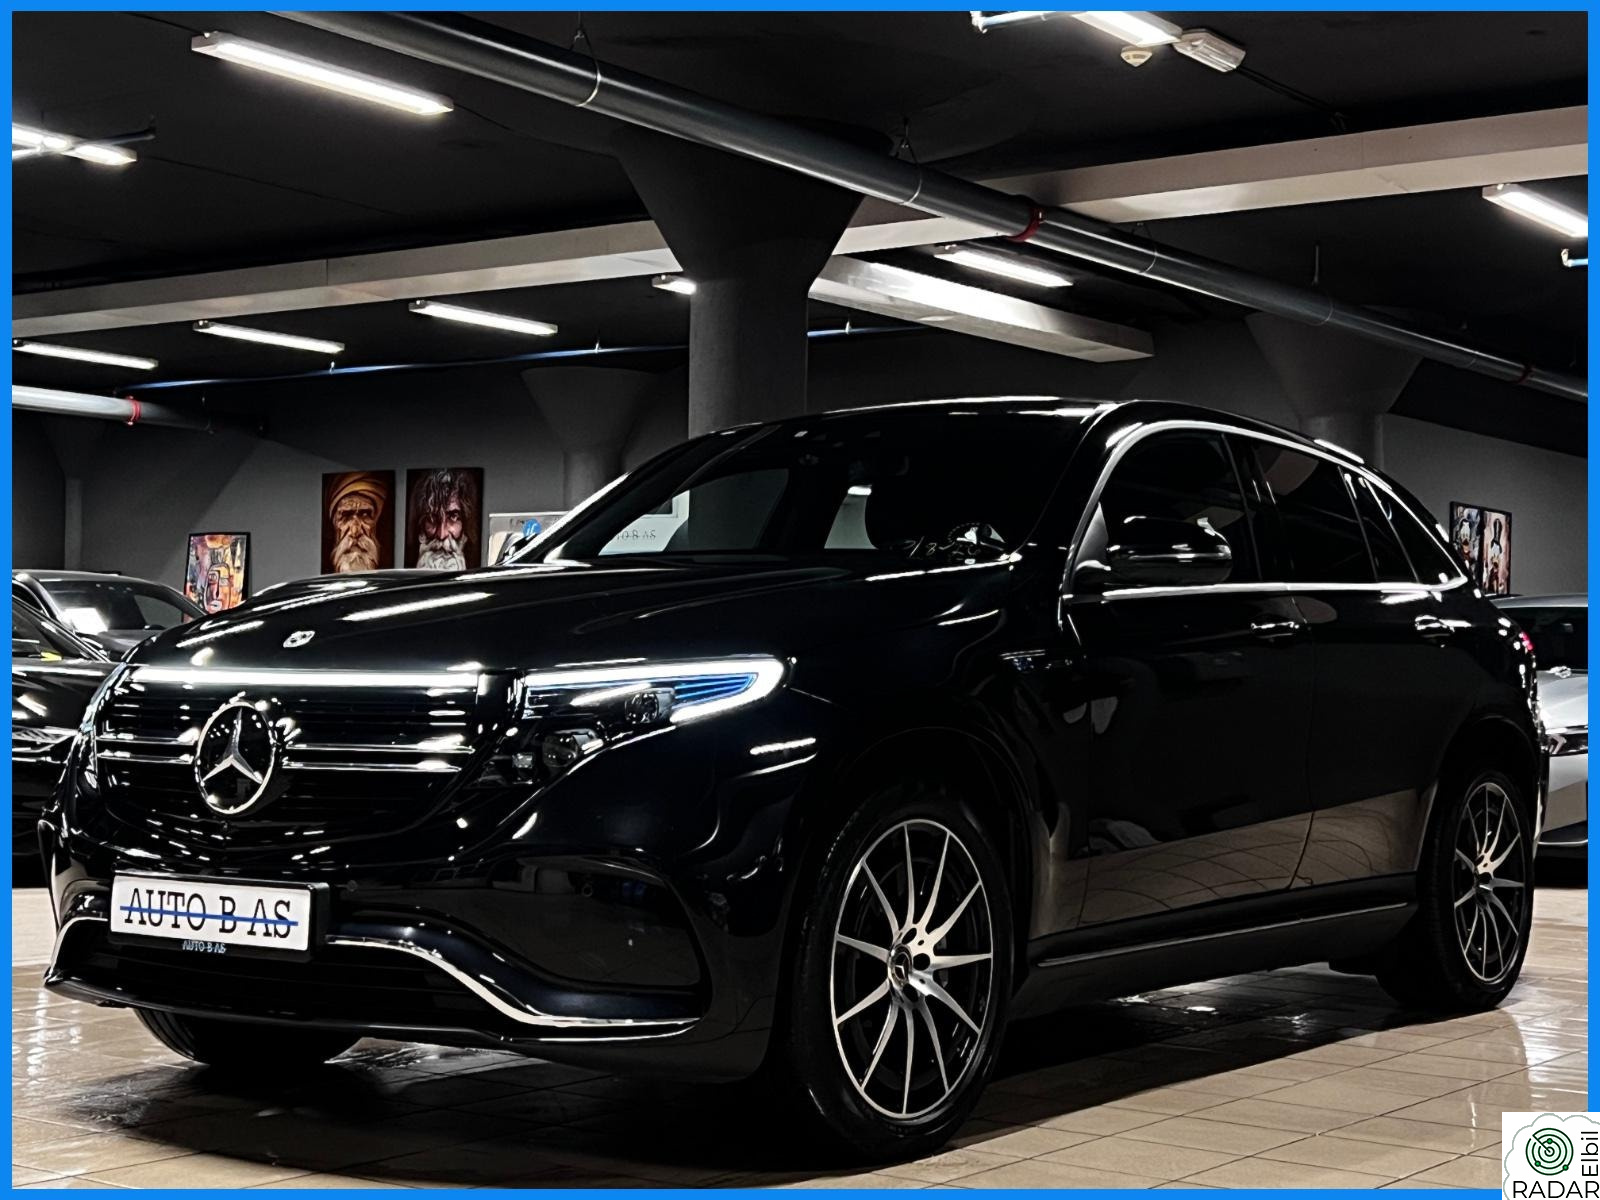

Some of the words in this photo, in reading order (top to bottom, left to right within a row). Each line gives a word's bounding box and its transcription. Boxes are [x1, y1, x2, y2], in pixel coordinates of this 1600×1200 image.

[124, 888, 207, 931] AUTO
[219, 896, 238, 934] B
[247, 899, 292, 938] AS
